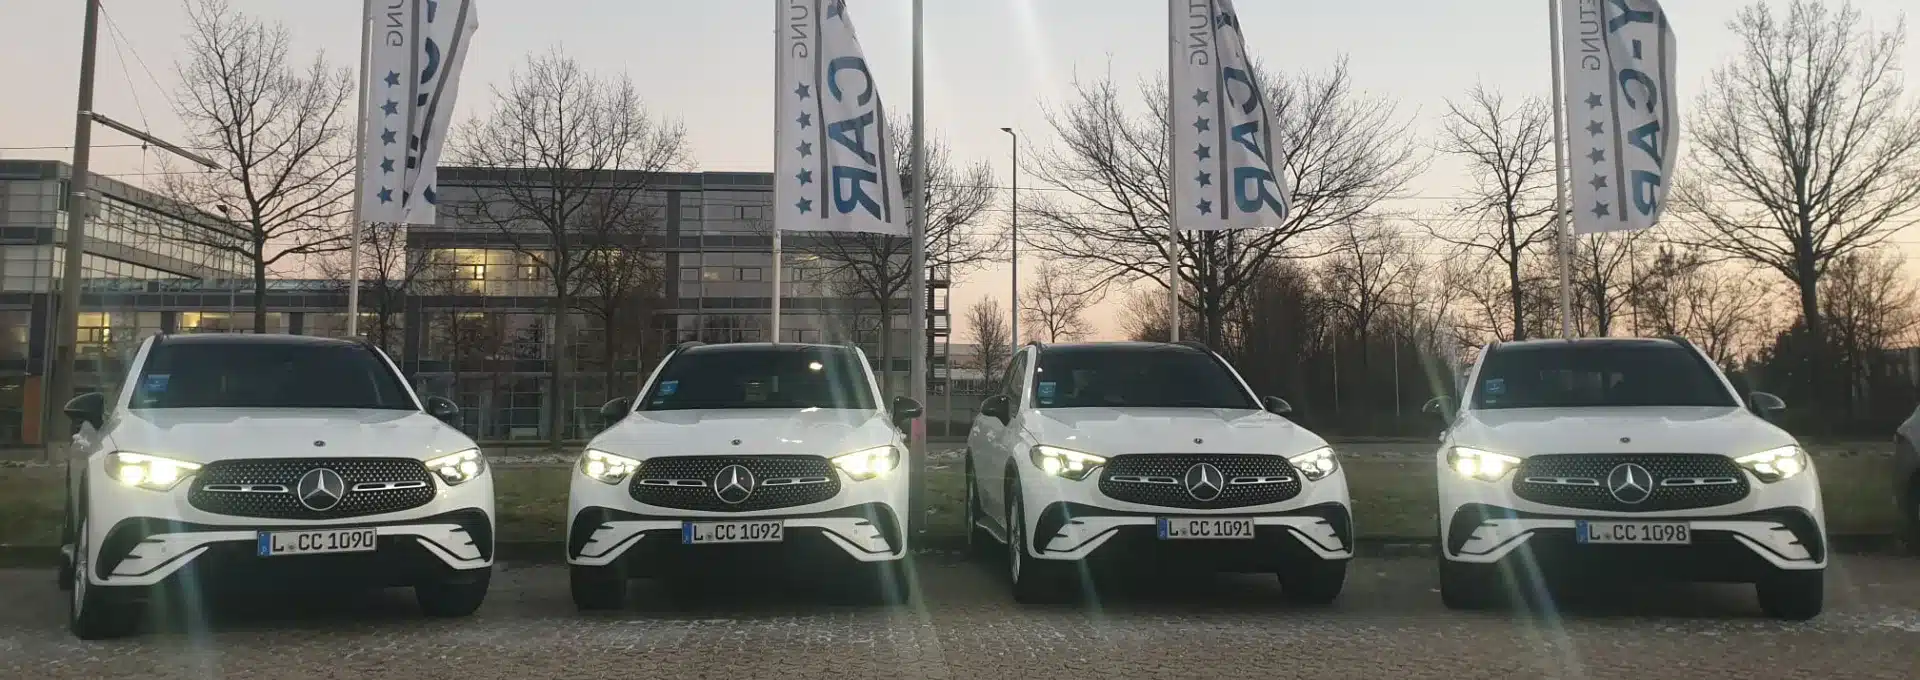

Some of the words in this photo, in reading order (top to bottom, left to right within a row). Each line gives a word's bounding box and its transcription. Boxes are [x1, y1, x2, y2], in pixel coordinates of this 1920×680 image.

[693, 525, 704, 541] L
[715, 524, 736, 540] CC
[740, 523, 780, 539] 1092
[1168, 520, 1179, 536] L
[1189, 520, 1210, 536] CC
[1213, 520, 1252, 536] 1091
[1589, 524, 1601, 540] L
[1613, 524, 1637, 540] CC
[1641, 524, 1687, 541] 1098
[272, 535, 285, 552] L
[298, 533, 323, 550] CC
[327, 530, 374, 550] 1090
